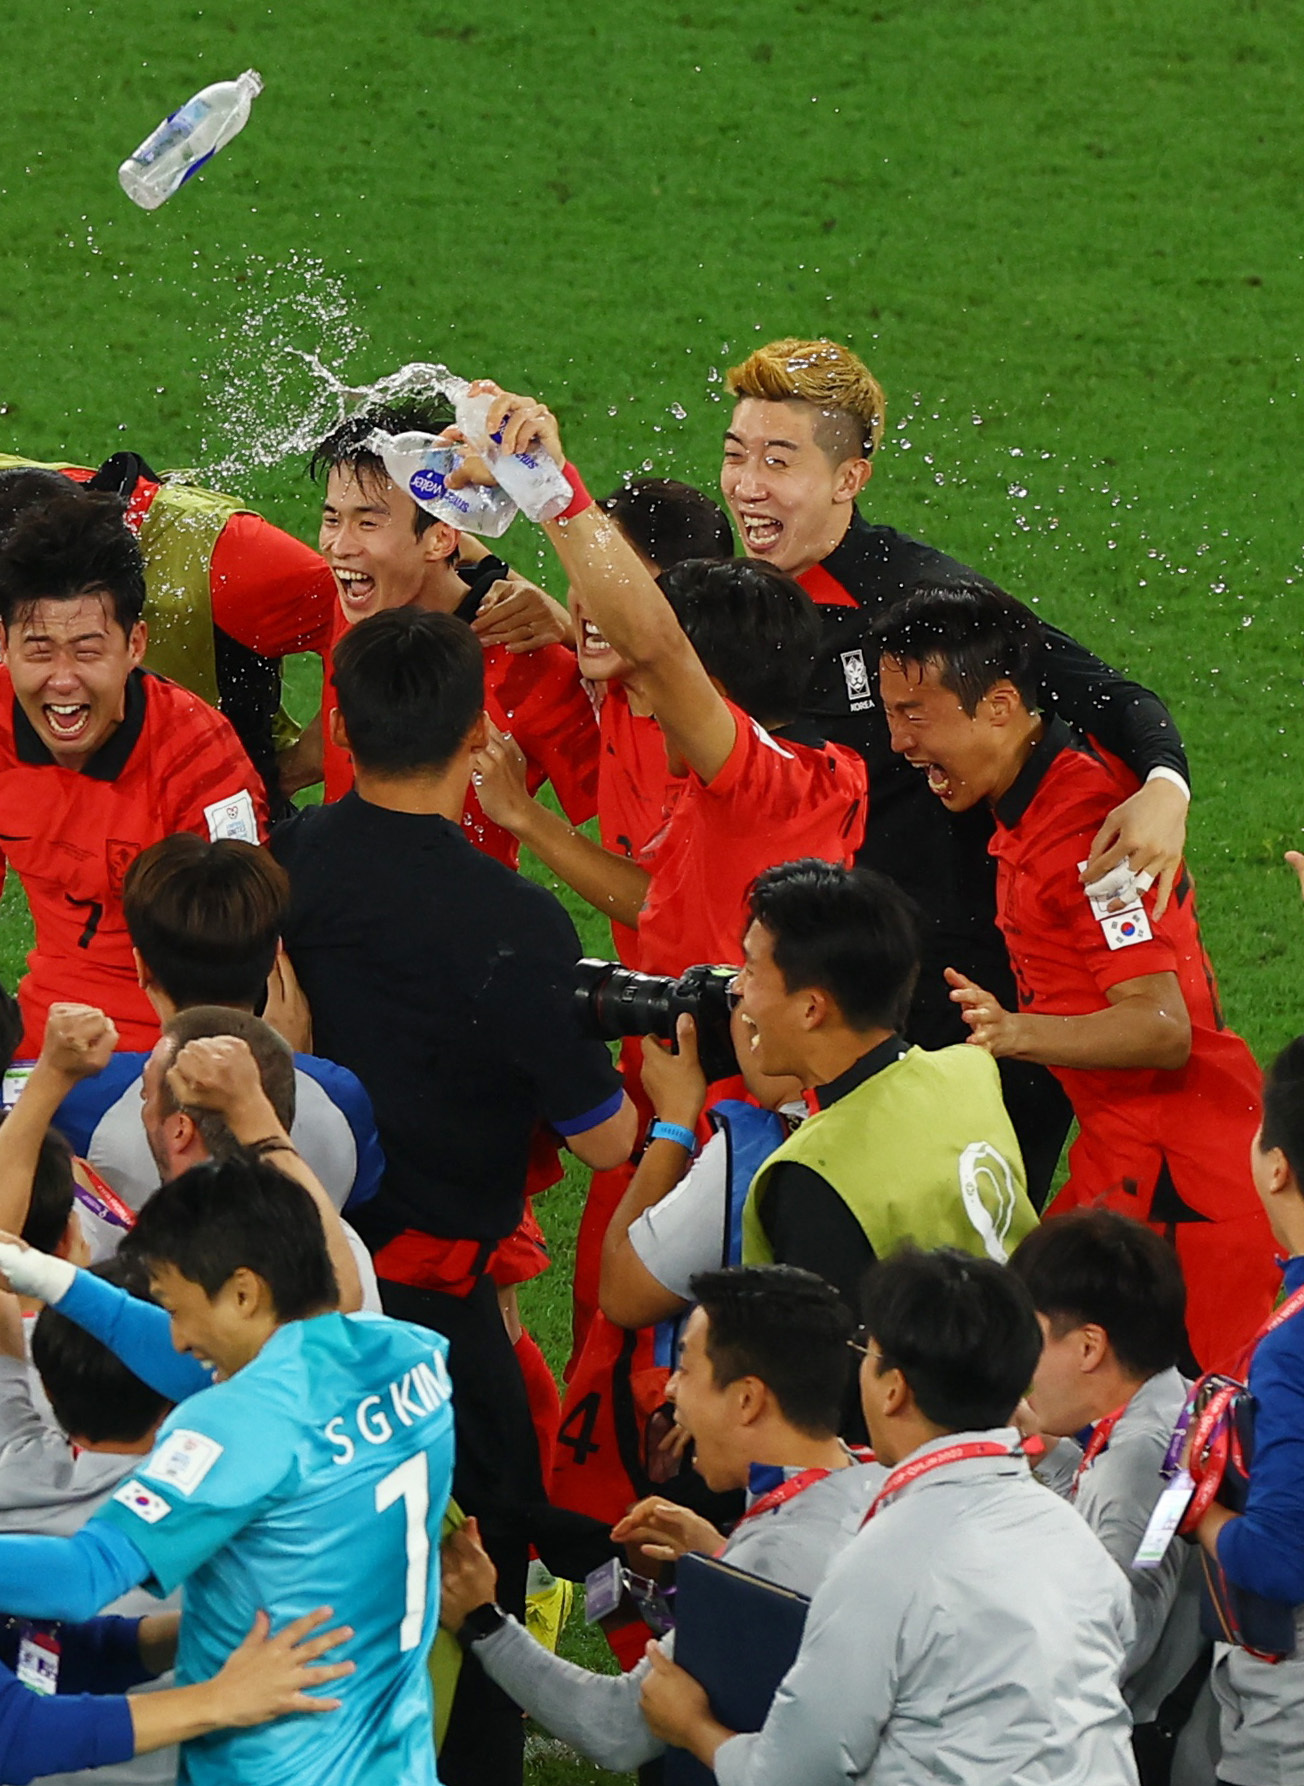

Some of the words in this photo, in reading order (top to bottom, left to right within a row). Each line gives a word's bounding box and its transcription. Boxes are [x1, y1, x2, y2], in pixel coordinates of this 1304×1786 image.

[411, 475, 442, 498] water
[64, 891, 103, 949] 7
[558, 1392, 601, 1465] 4
[375, 1450, 430, 1652] 1
